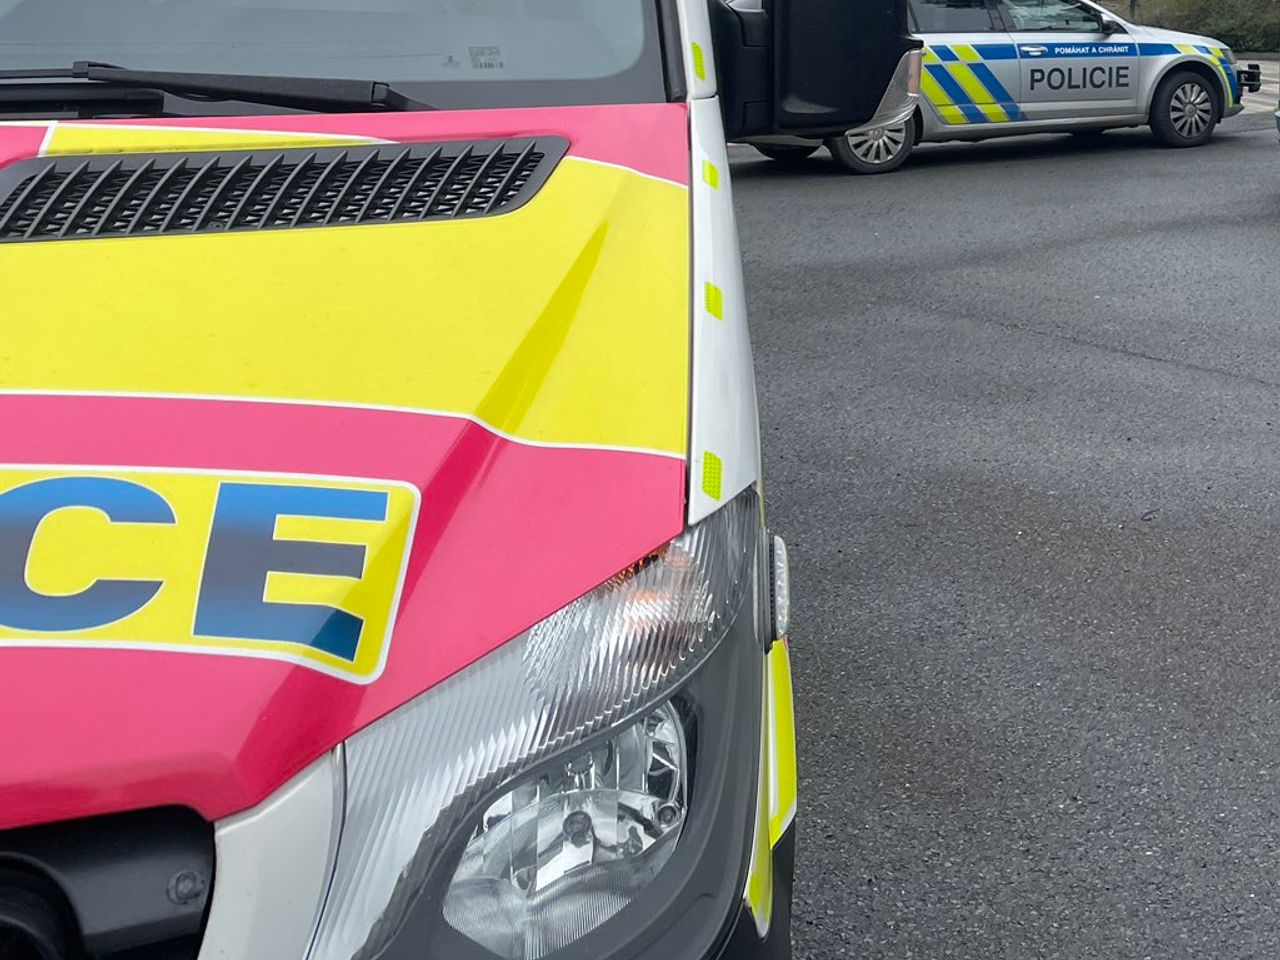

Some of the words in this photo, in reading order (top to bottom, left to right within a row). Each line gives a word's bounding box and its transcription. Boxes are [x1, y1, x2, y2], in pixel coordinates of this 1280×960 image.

[1054, 45, 1090, 54] POMÁHAT
[1091, 46, 1097, 54] A
[1098, 45, 1129, 53] CHRÁNIT
[1030, 66, 1129, 91] POLICIE
